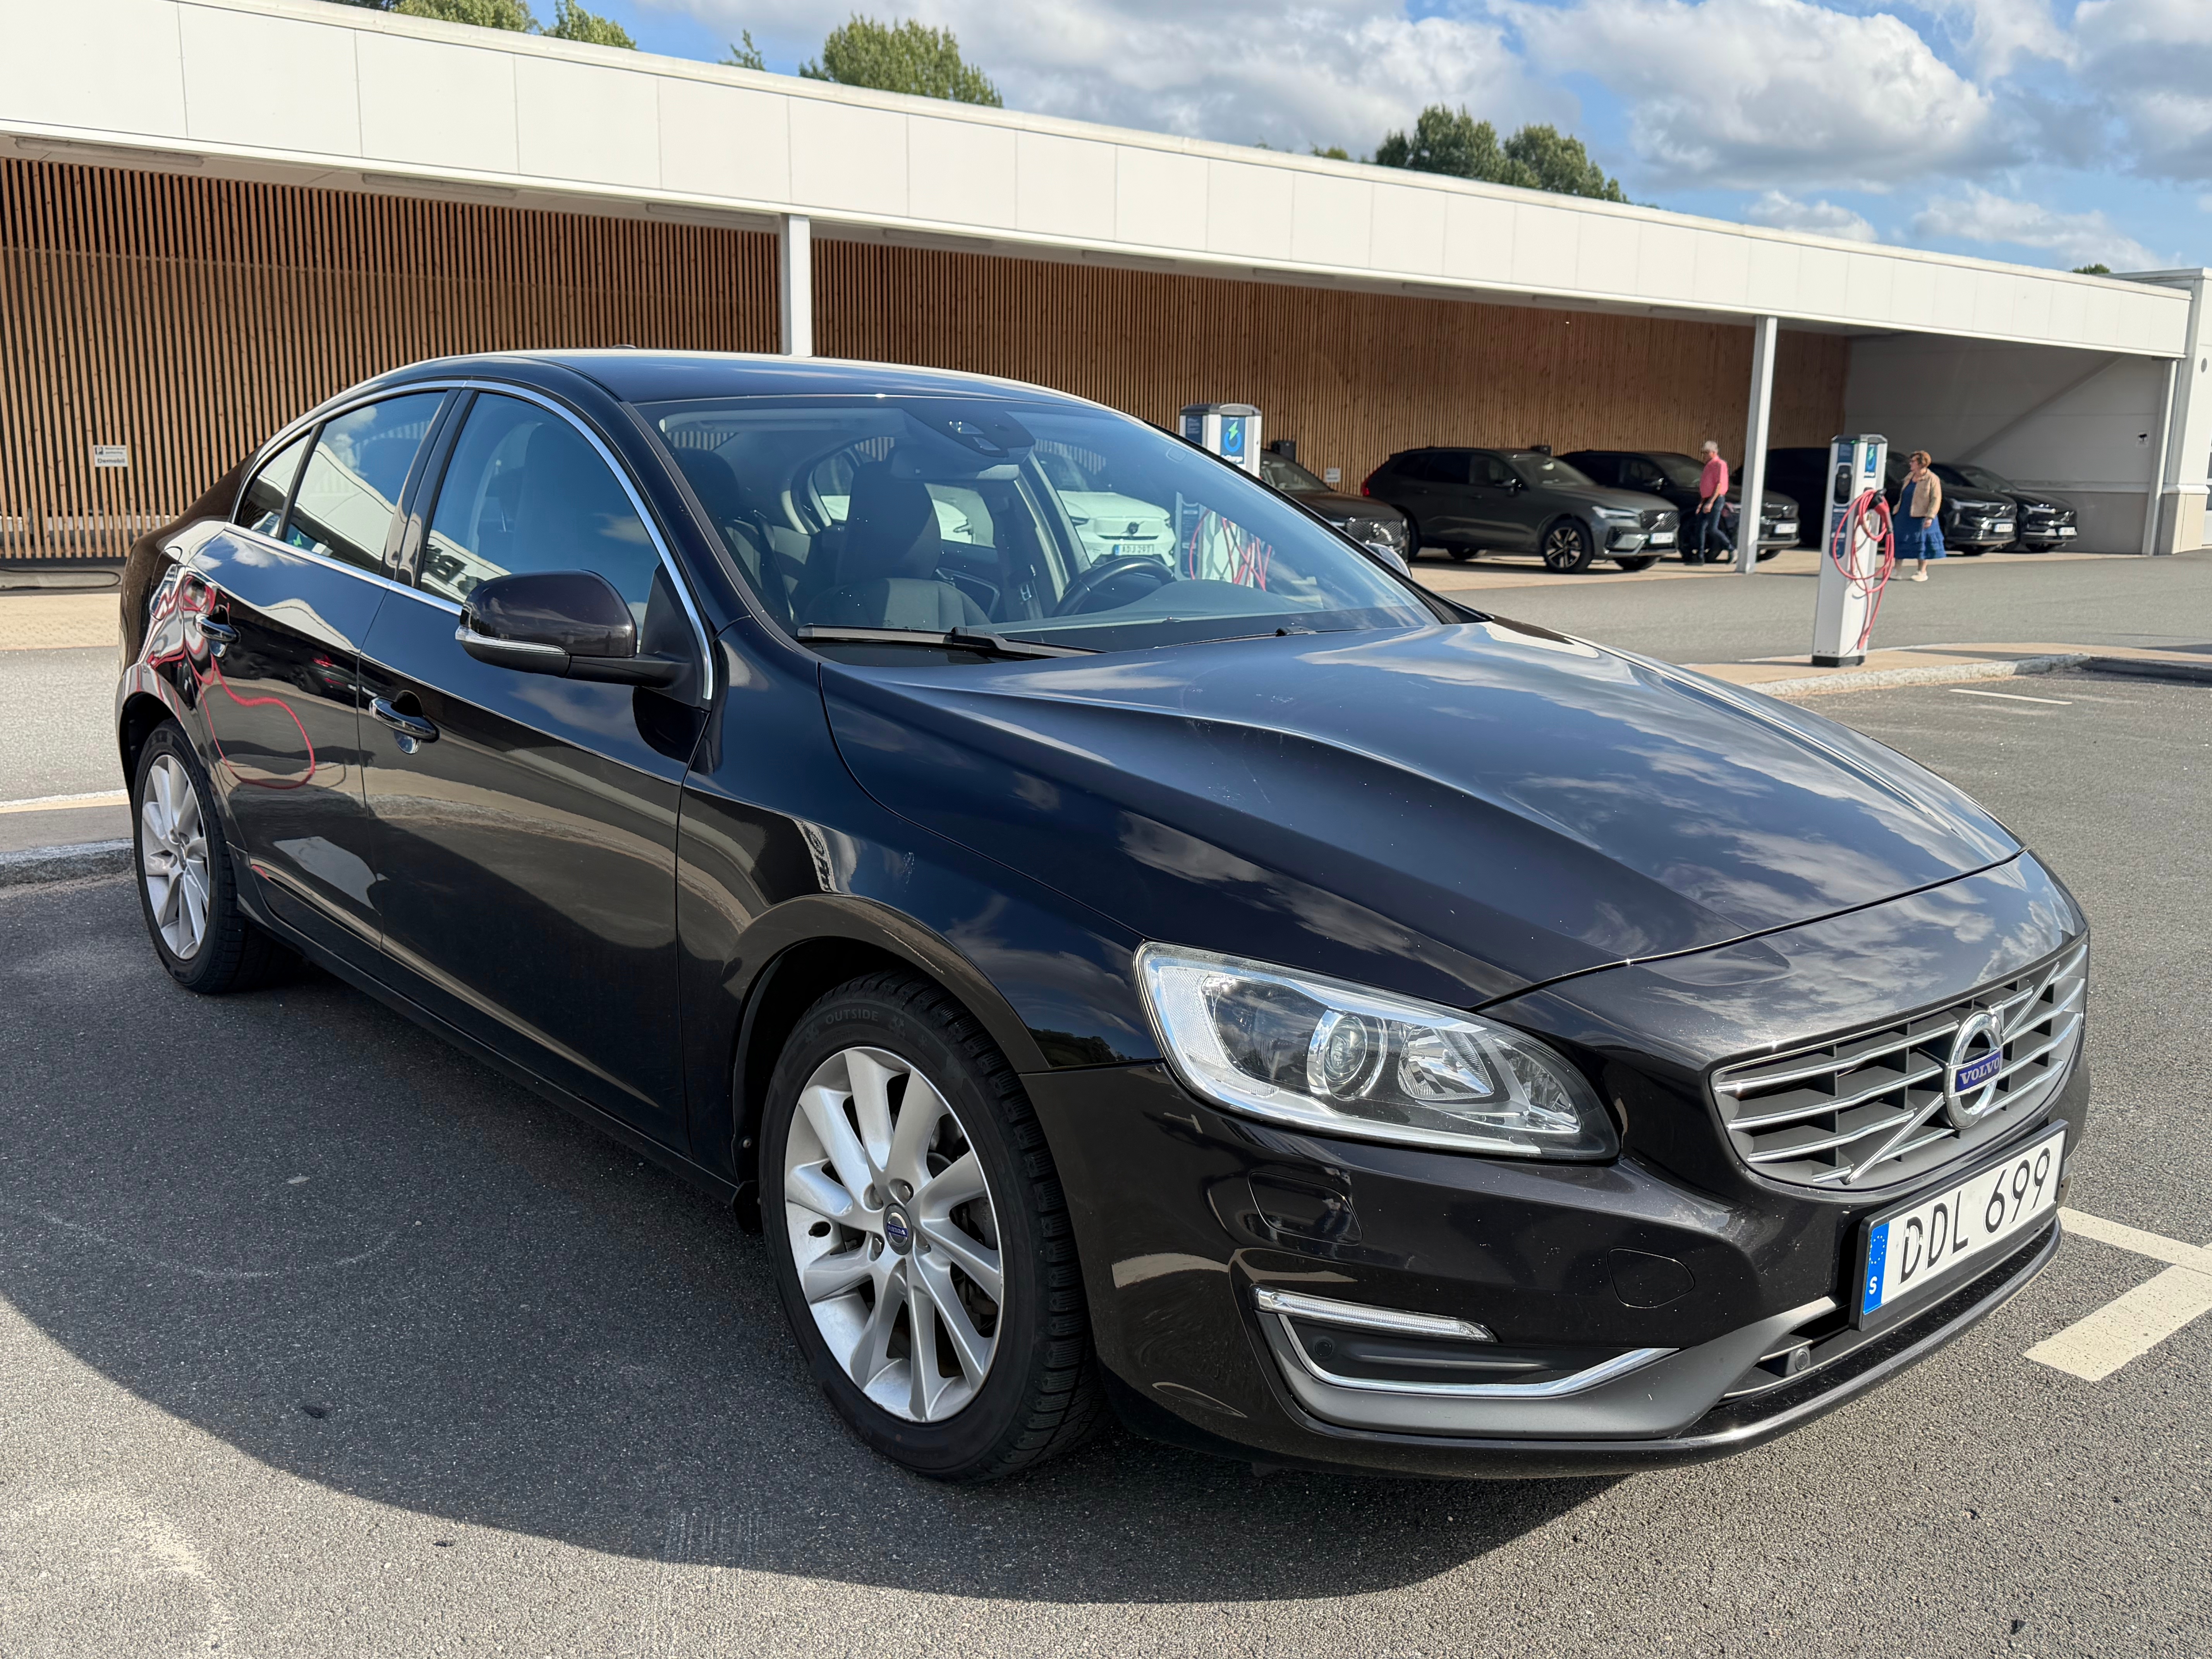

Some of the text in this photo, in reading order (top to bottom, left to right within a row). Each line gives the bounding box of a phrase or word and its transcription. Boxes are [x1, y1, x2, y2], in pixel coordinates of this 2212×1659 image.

[826, 1009, 879, 1024] OUTSIDE
[1960, 1057, 1999, 1084] VOLVO
[1899, 1147, 2051, 1285] DDL 699
[887, 1225, 906, 1235] VOLVO
[1869, 1276, 1877, 1294] S
